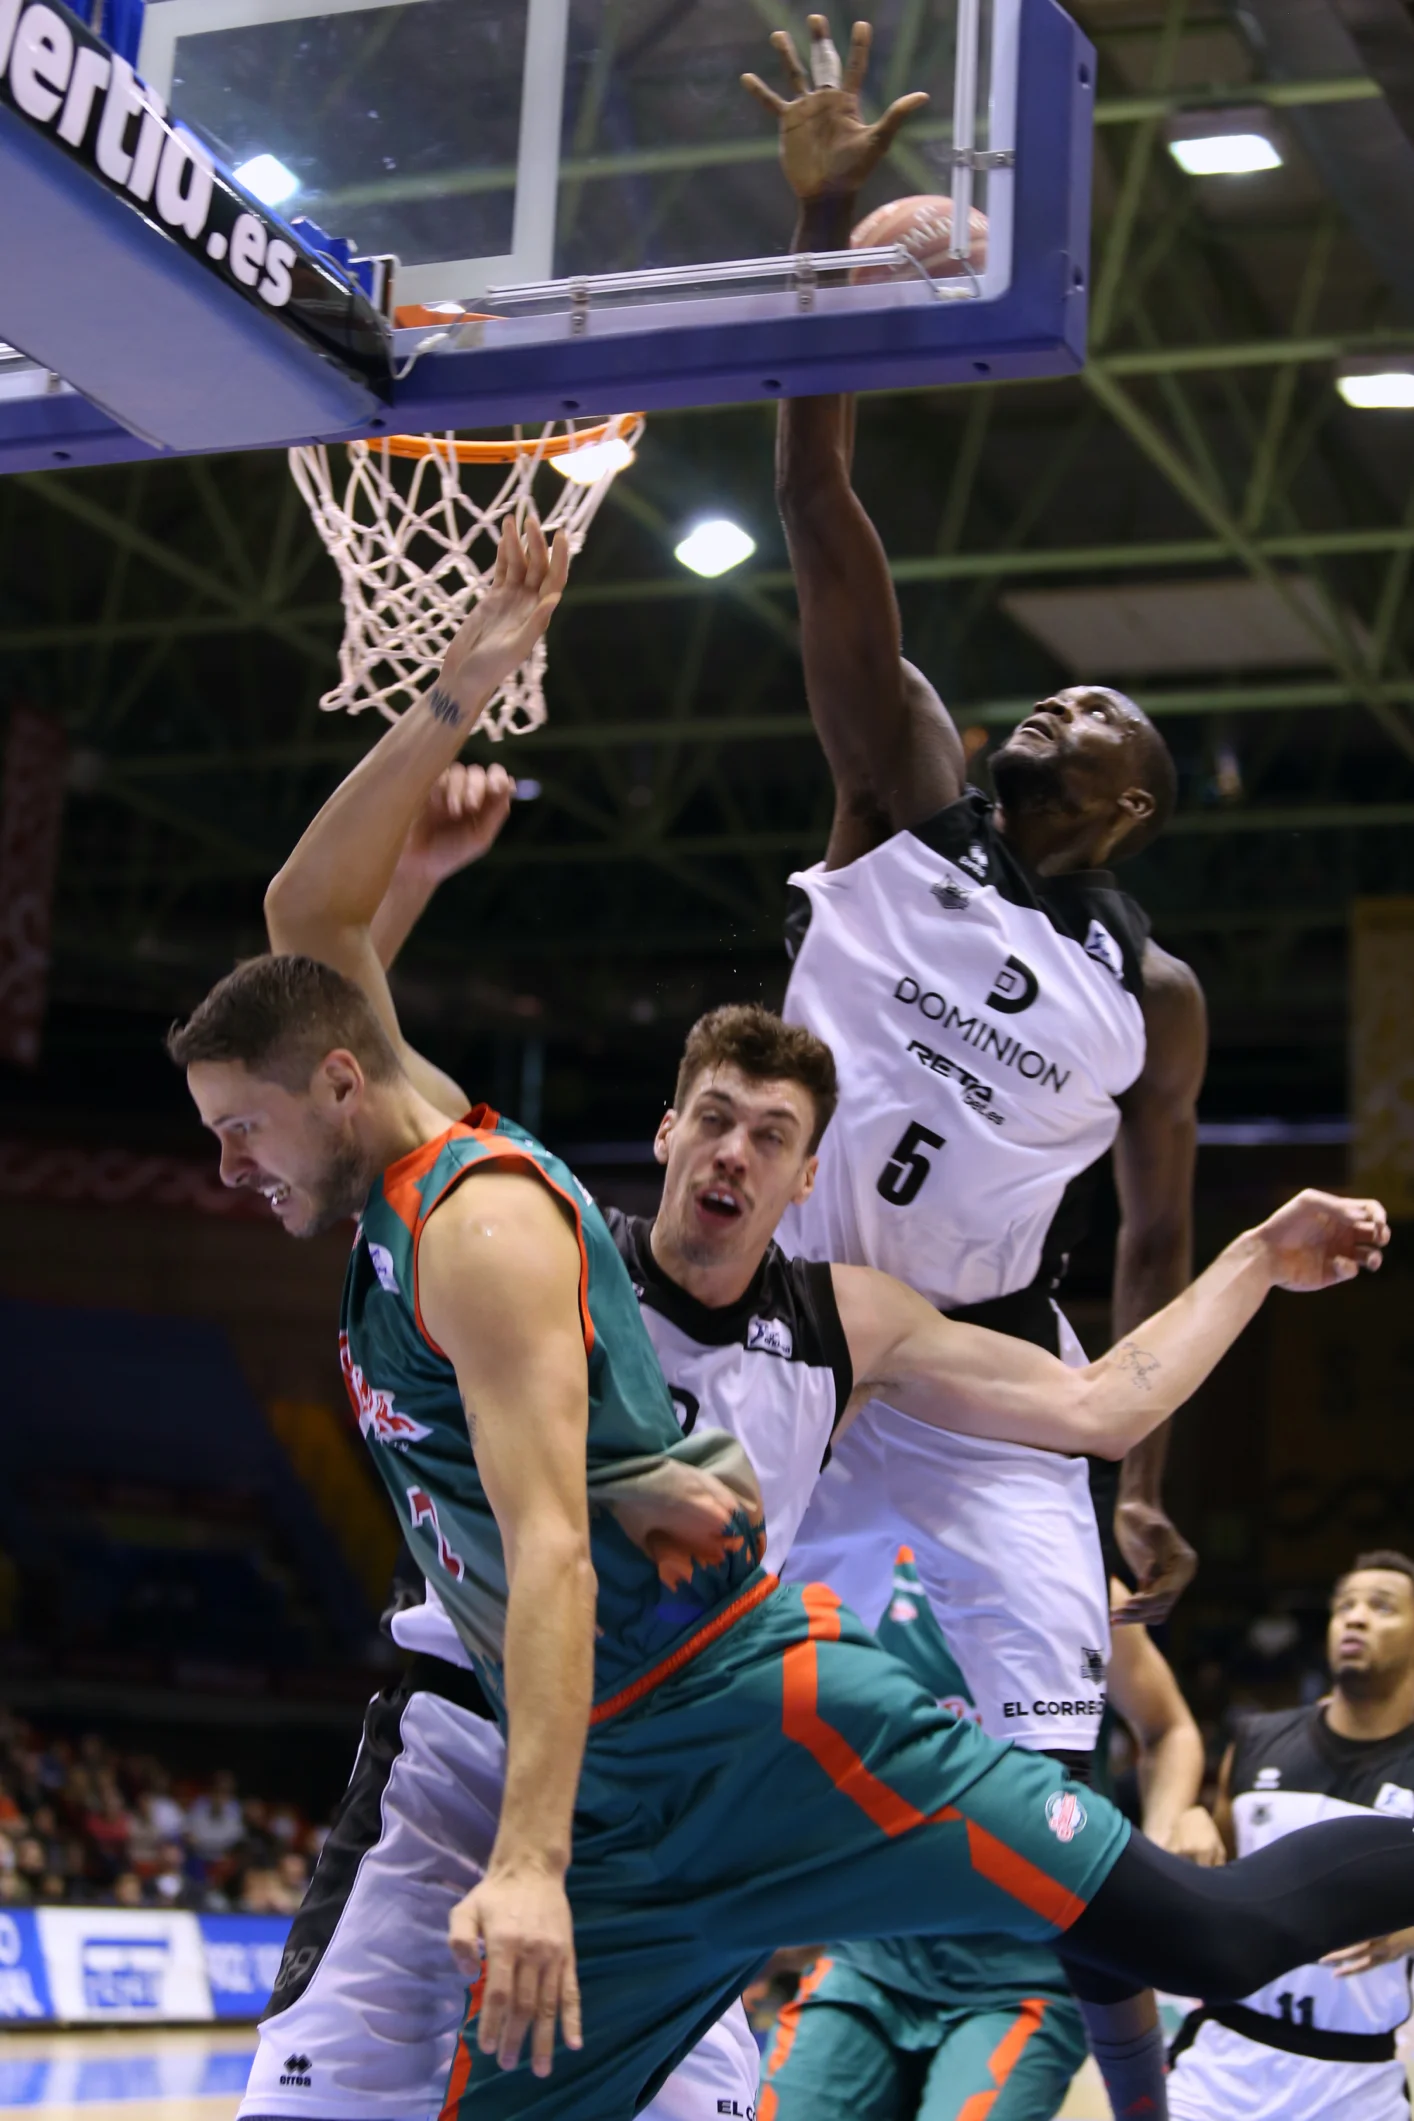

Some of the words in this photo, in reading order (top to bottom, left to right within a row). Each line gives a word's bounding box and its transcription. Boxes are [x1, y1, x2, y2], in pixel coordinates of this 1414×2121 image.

[892, 976, 1071, 1094] DOMINION
[876, 1120, 946, 1207] 5
[1003, 1702, 1029, 1718] EL
[1276, 1992, 1315, 2029] 11
[717, 2099, 743, 2117] EL
